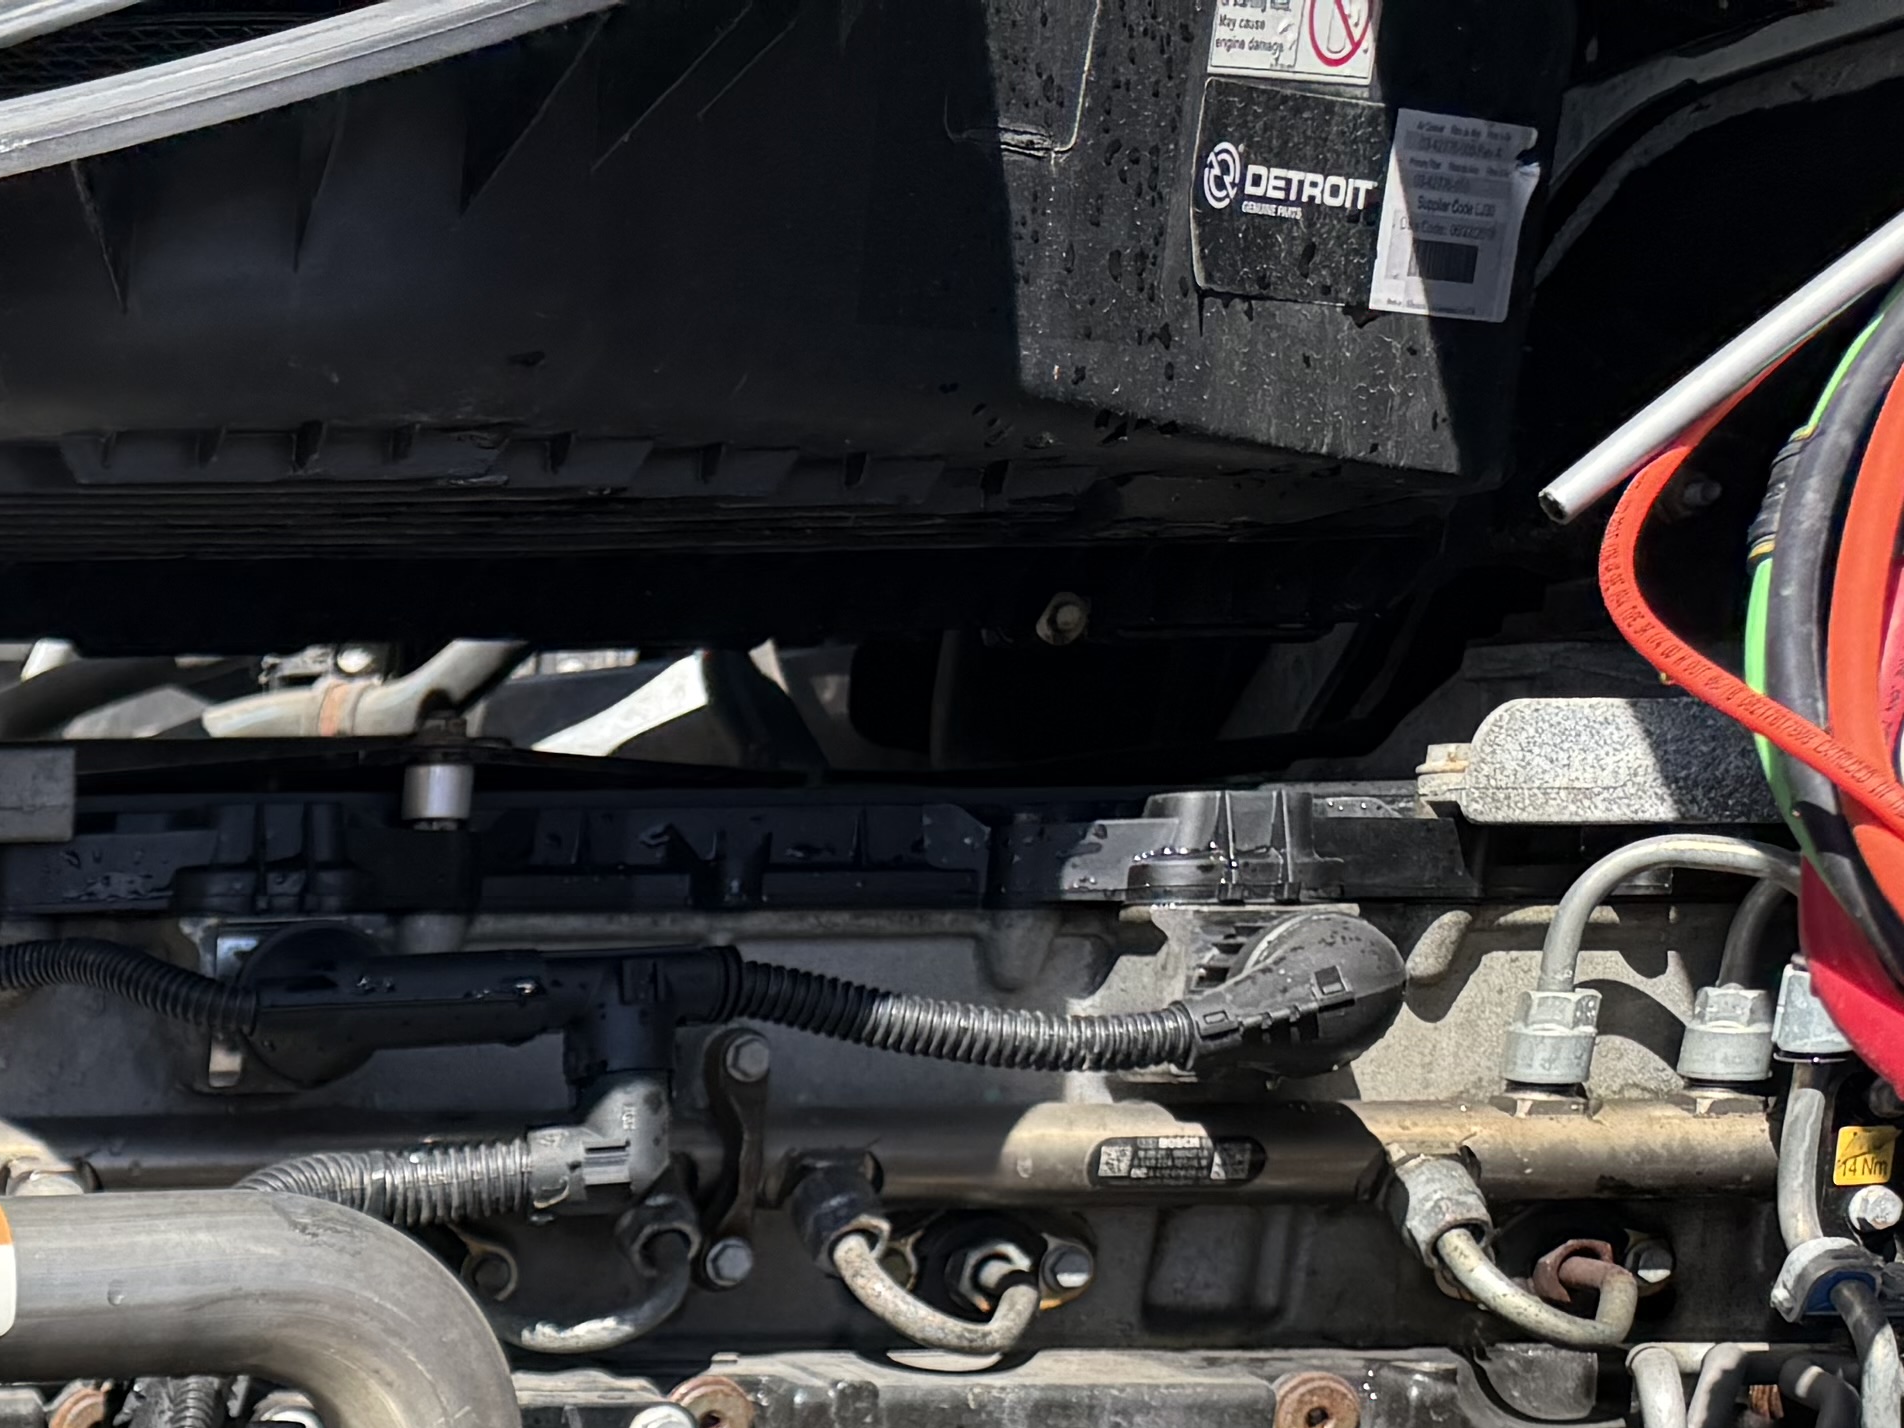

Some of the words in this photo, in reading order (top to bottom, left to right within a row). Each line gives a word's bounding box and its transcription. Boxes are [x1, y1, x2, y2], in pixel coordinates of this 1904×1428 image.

[1215, 36, 1246, 52] engine
[1244, 163, 1374, 210] DETROIT
[1841, 1157, 1857, 1176] 14
[1861, 1156, 1887, 1175] Nm
